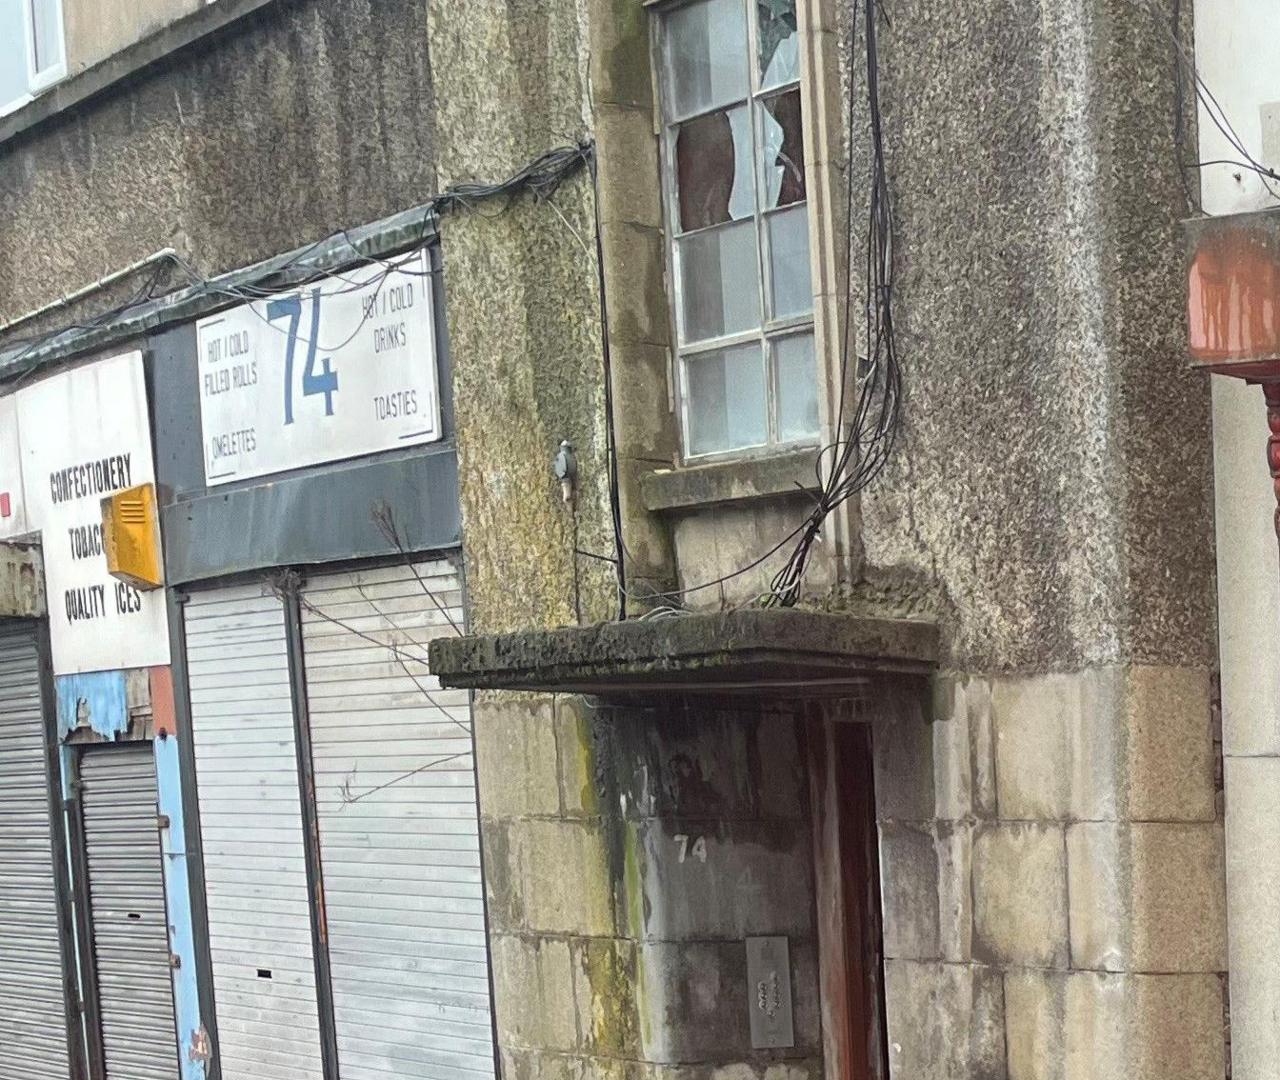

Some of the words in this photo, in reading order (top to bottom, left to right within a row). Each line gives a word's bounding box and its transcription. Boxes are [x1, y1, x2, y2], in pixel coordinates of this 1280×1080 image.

[390, 283, 413, 312] COLD
[374, 322, 407, 353] DRINKS
[266, 287, 339, 425] 74
[205, 368, 230, 397] FILLED
[232, 361, 257, 389] ROLLS
[373, 390, 418, 421] TOASTIES
[212, 427, 256, 459] OMELETTES
[50, 452, 131, 504] CONFECTIONERY
[68, 522, 106, 560] TOBAC
[65, 584, 105, 626] QUALITY
[114, 582, 141, 615] ICES
[674, 834, 707, 864] 74
